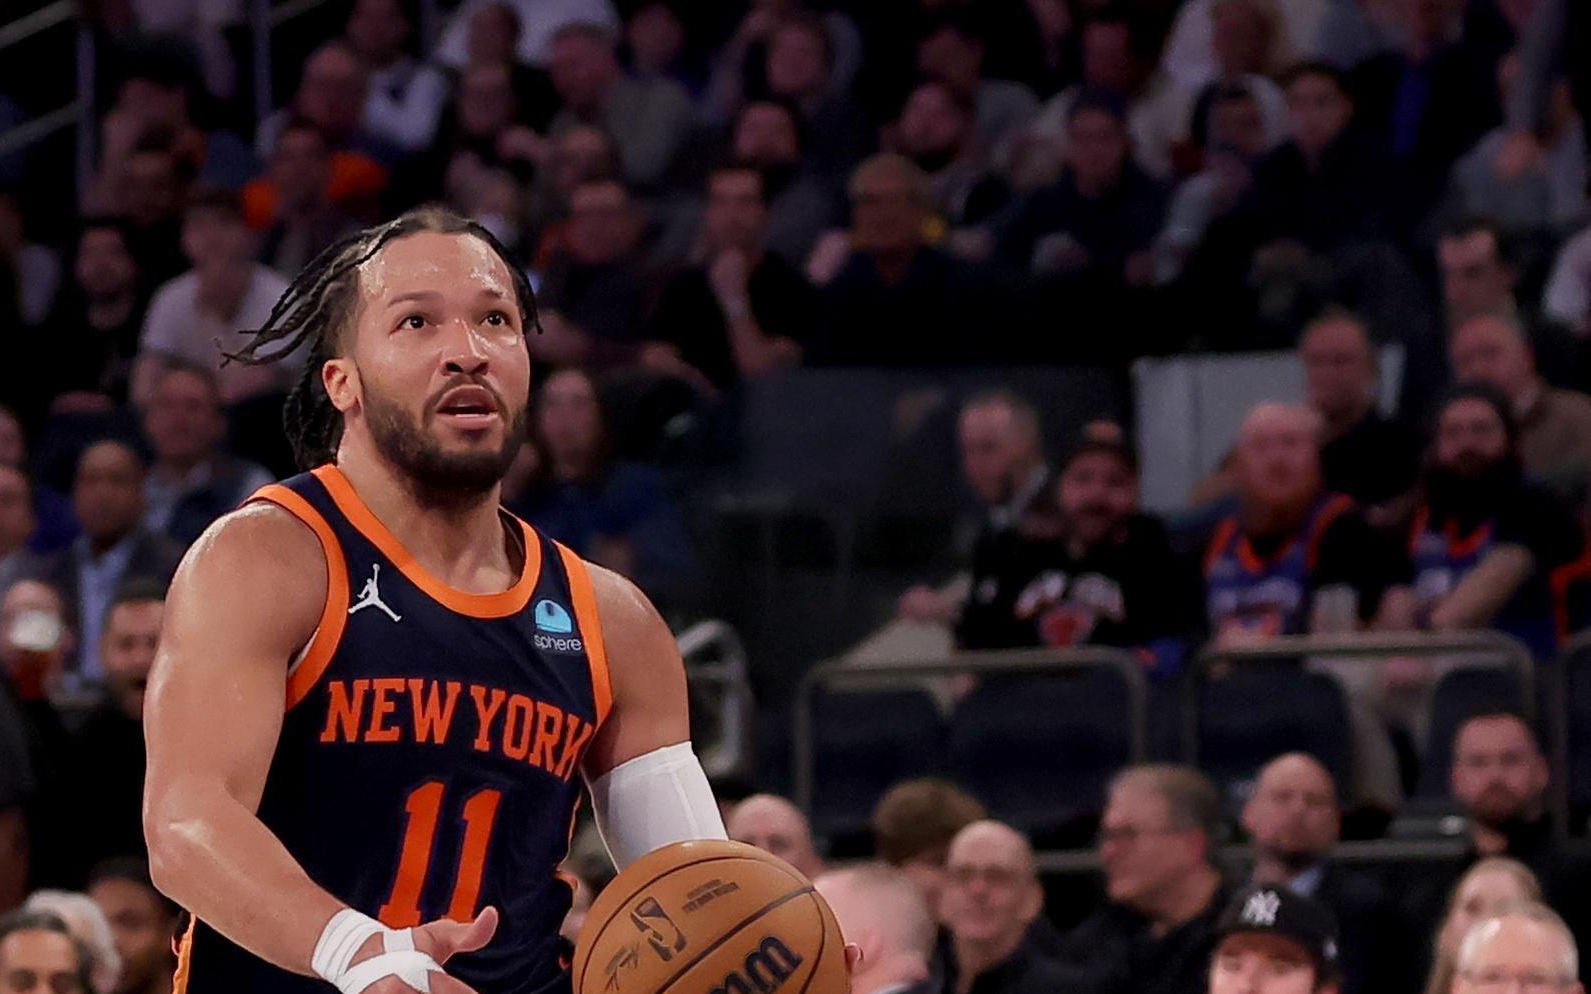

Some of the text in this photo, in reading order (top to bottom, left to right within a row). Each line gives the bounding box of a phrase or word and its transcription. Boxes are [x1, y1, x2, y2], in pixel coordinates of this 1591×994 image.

[534, 632, 583, 652] sphere
[320, 678, 593, 783] NEW YORK
[377, 780, 502, 929] 11
